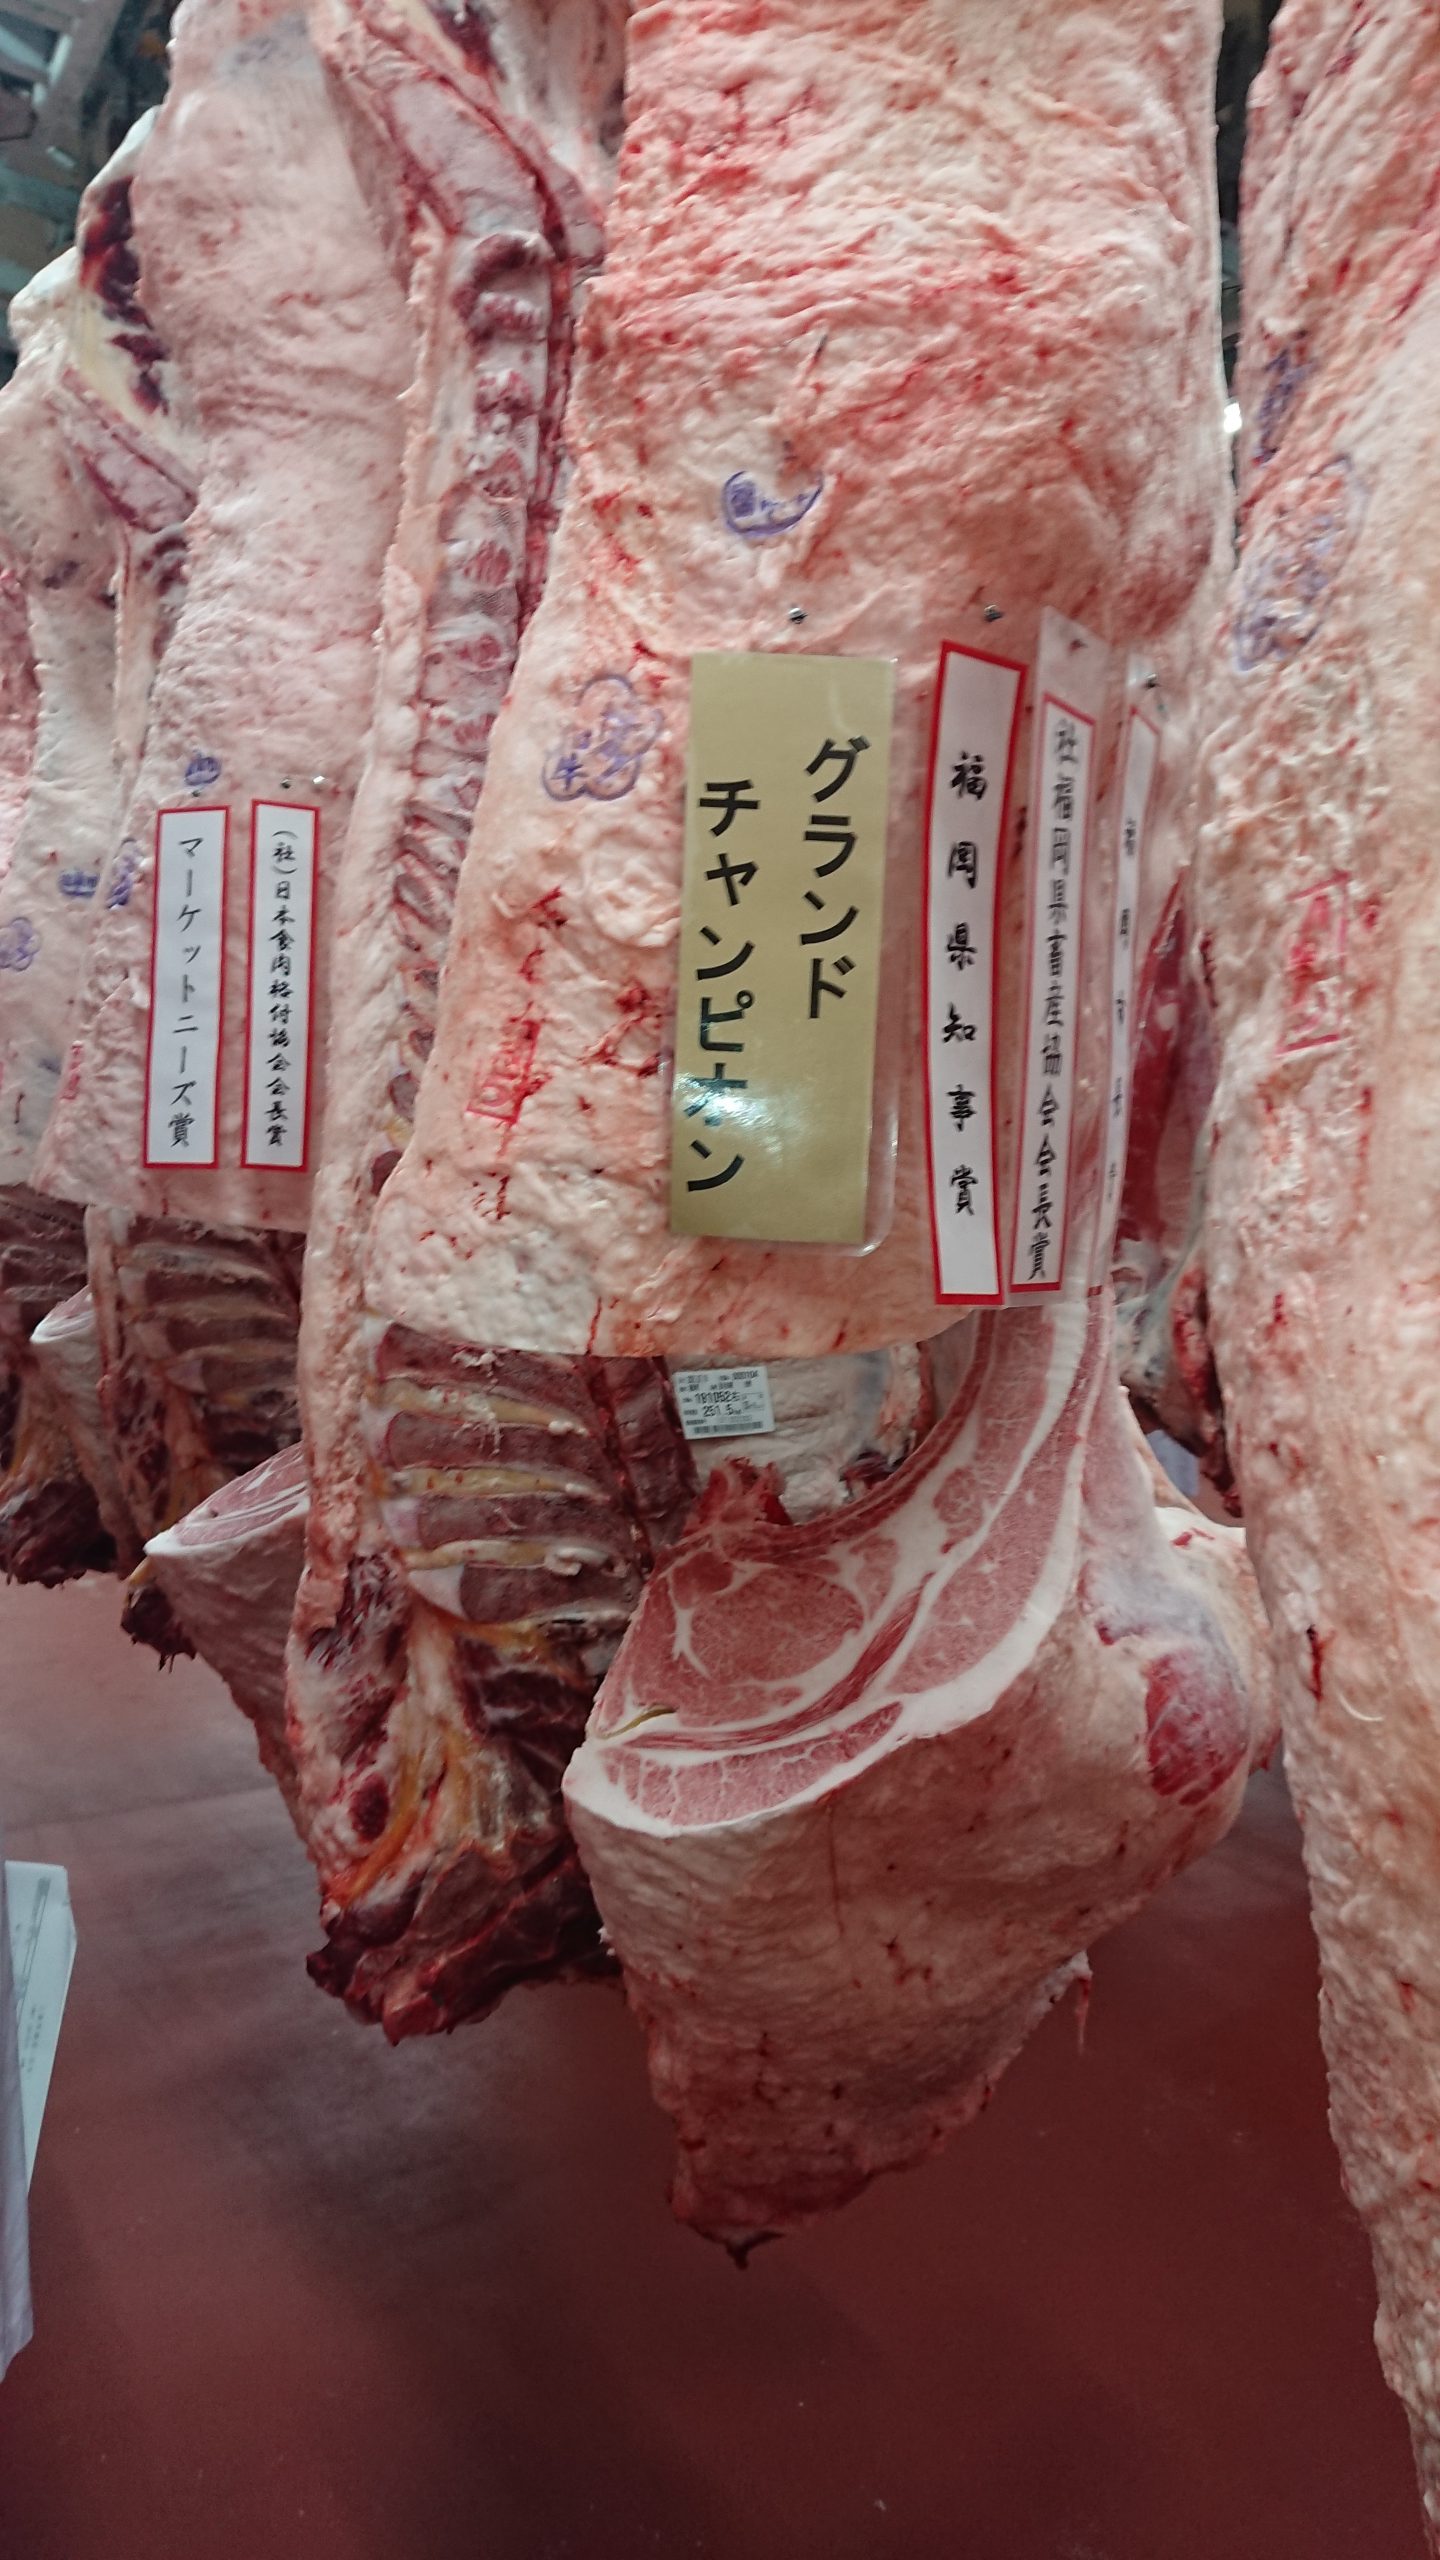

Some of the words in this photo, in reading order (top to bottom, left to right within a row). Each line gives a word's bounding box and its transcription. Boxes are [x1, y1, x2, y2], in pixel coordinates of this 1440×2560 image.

[168, 836, 205, 1148] マーケットニーズ賞
[684, 778, 760, 1193] チャンピオン
[799, 735, 870, 1018] グランド
[942, 752, 988, 1215] 福岡県知事賞
